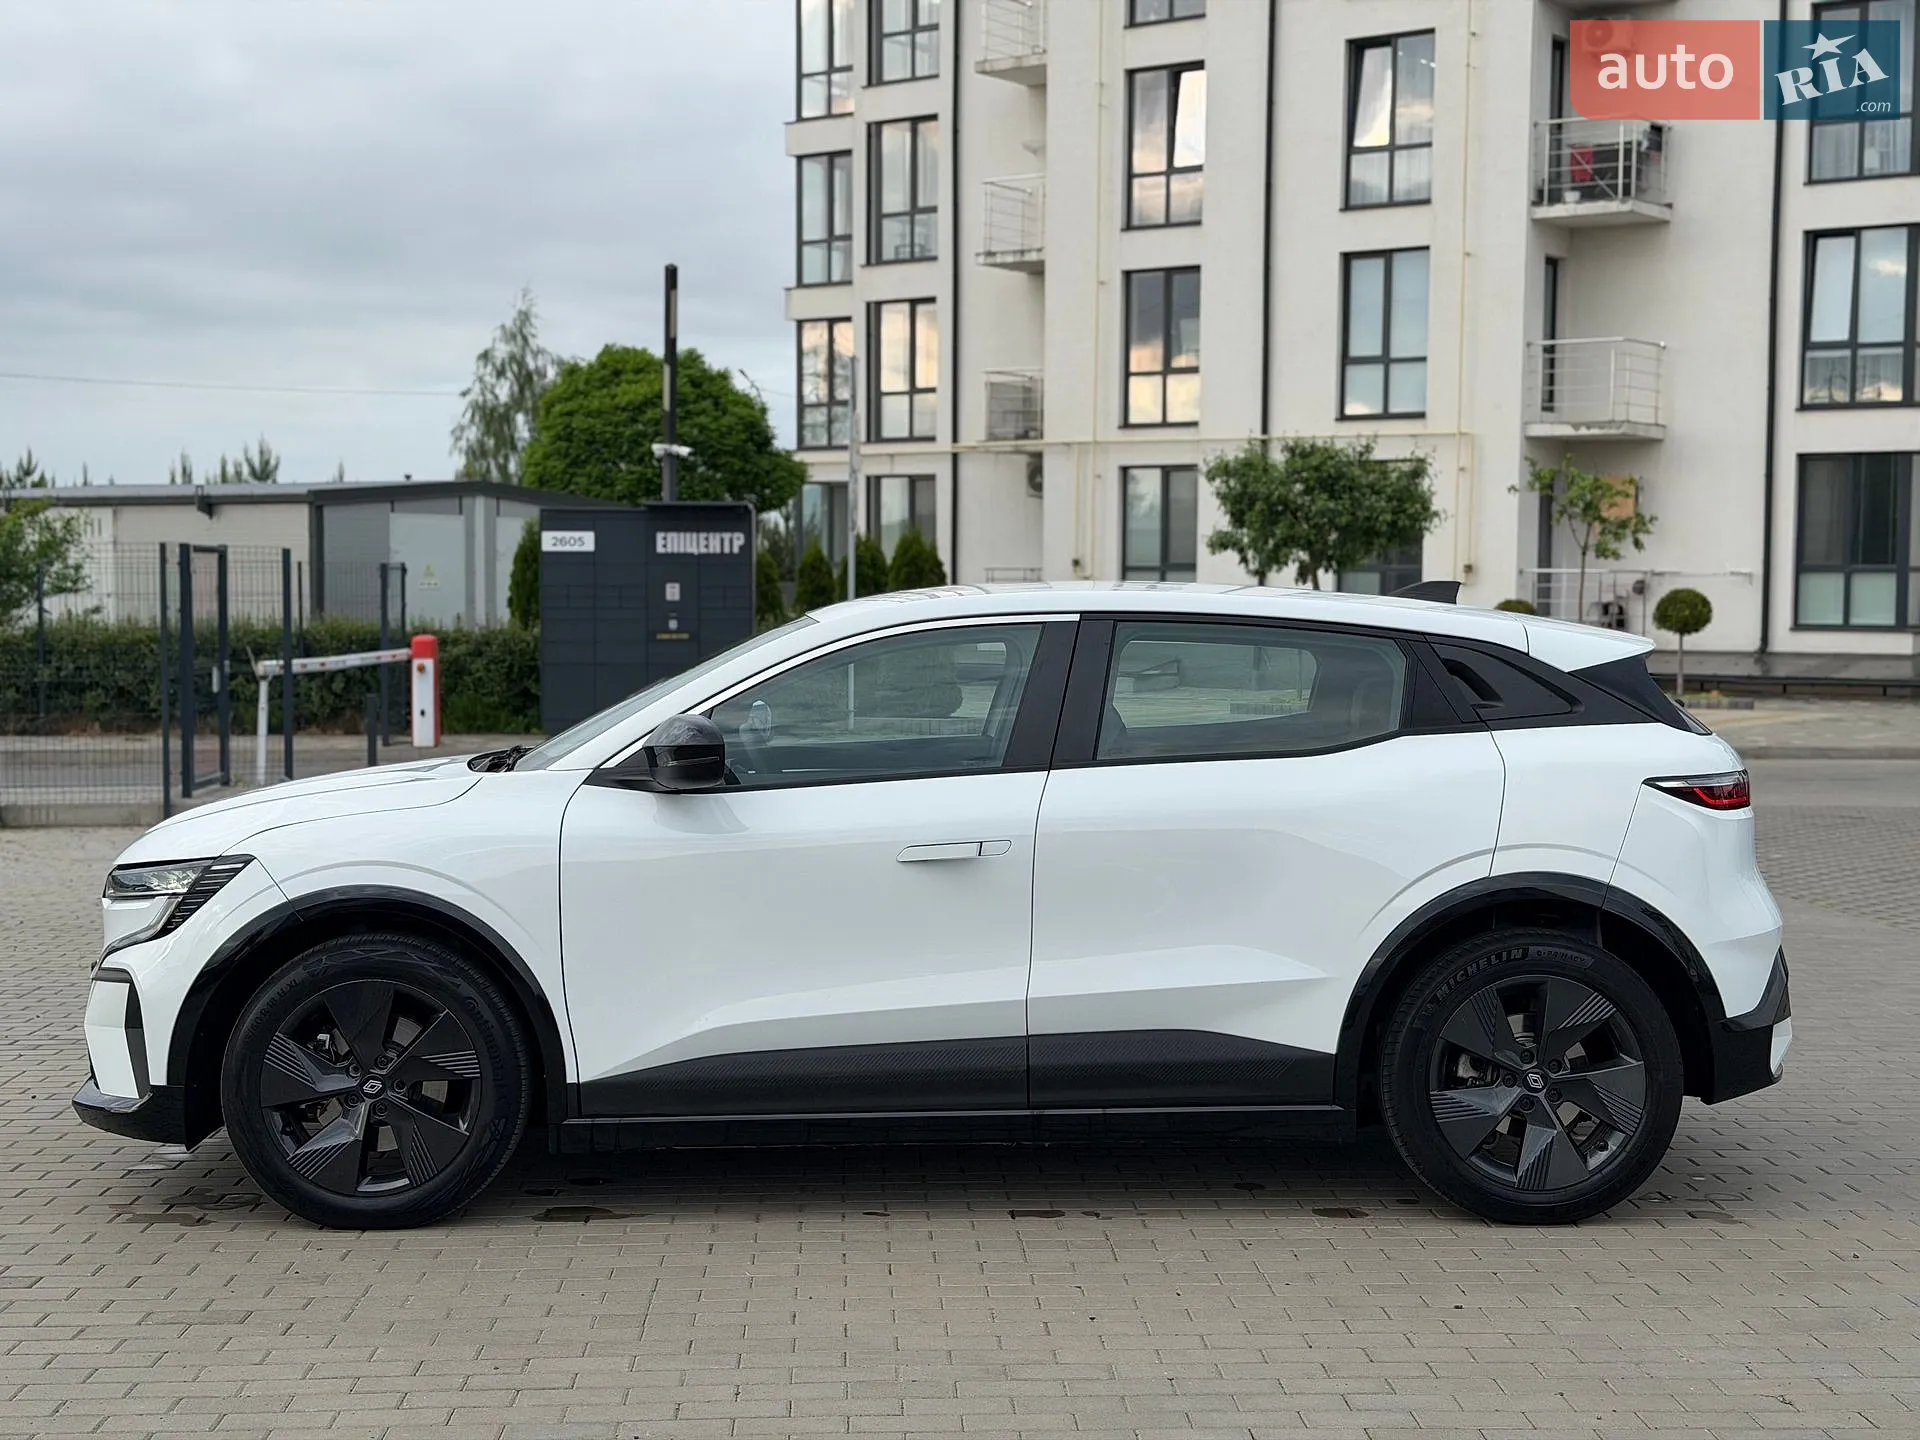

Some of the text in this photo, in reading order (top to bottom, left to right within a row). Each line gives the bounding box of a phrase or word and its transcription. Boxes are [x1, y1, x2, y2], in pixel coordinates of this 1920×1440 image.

[551, 535, 586, 547] 2605
[655, 531, 746, 555] ЕПІЦЕНТР
[1435, 948, 1524, 1002] MICHELIN
